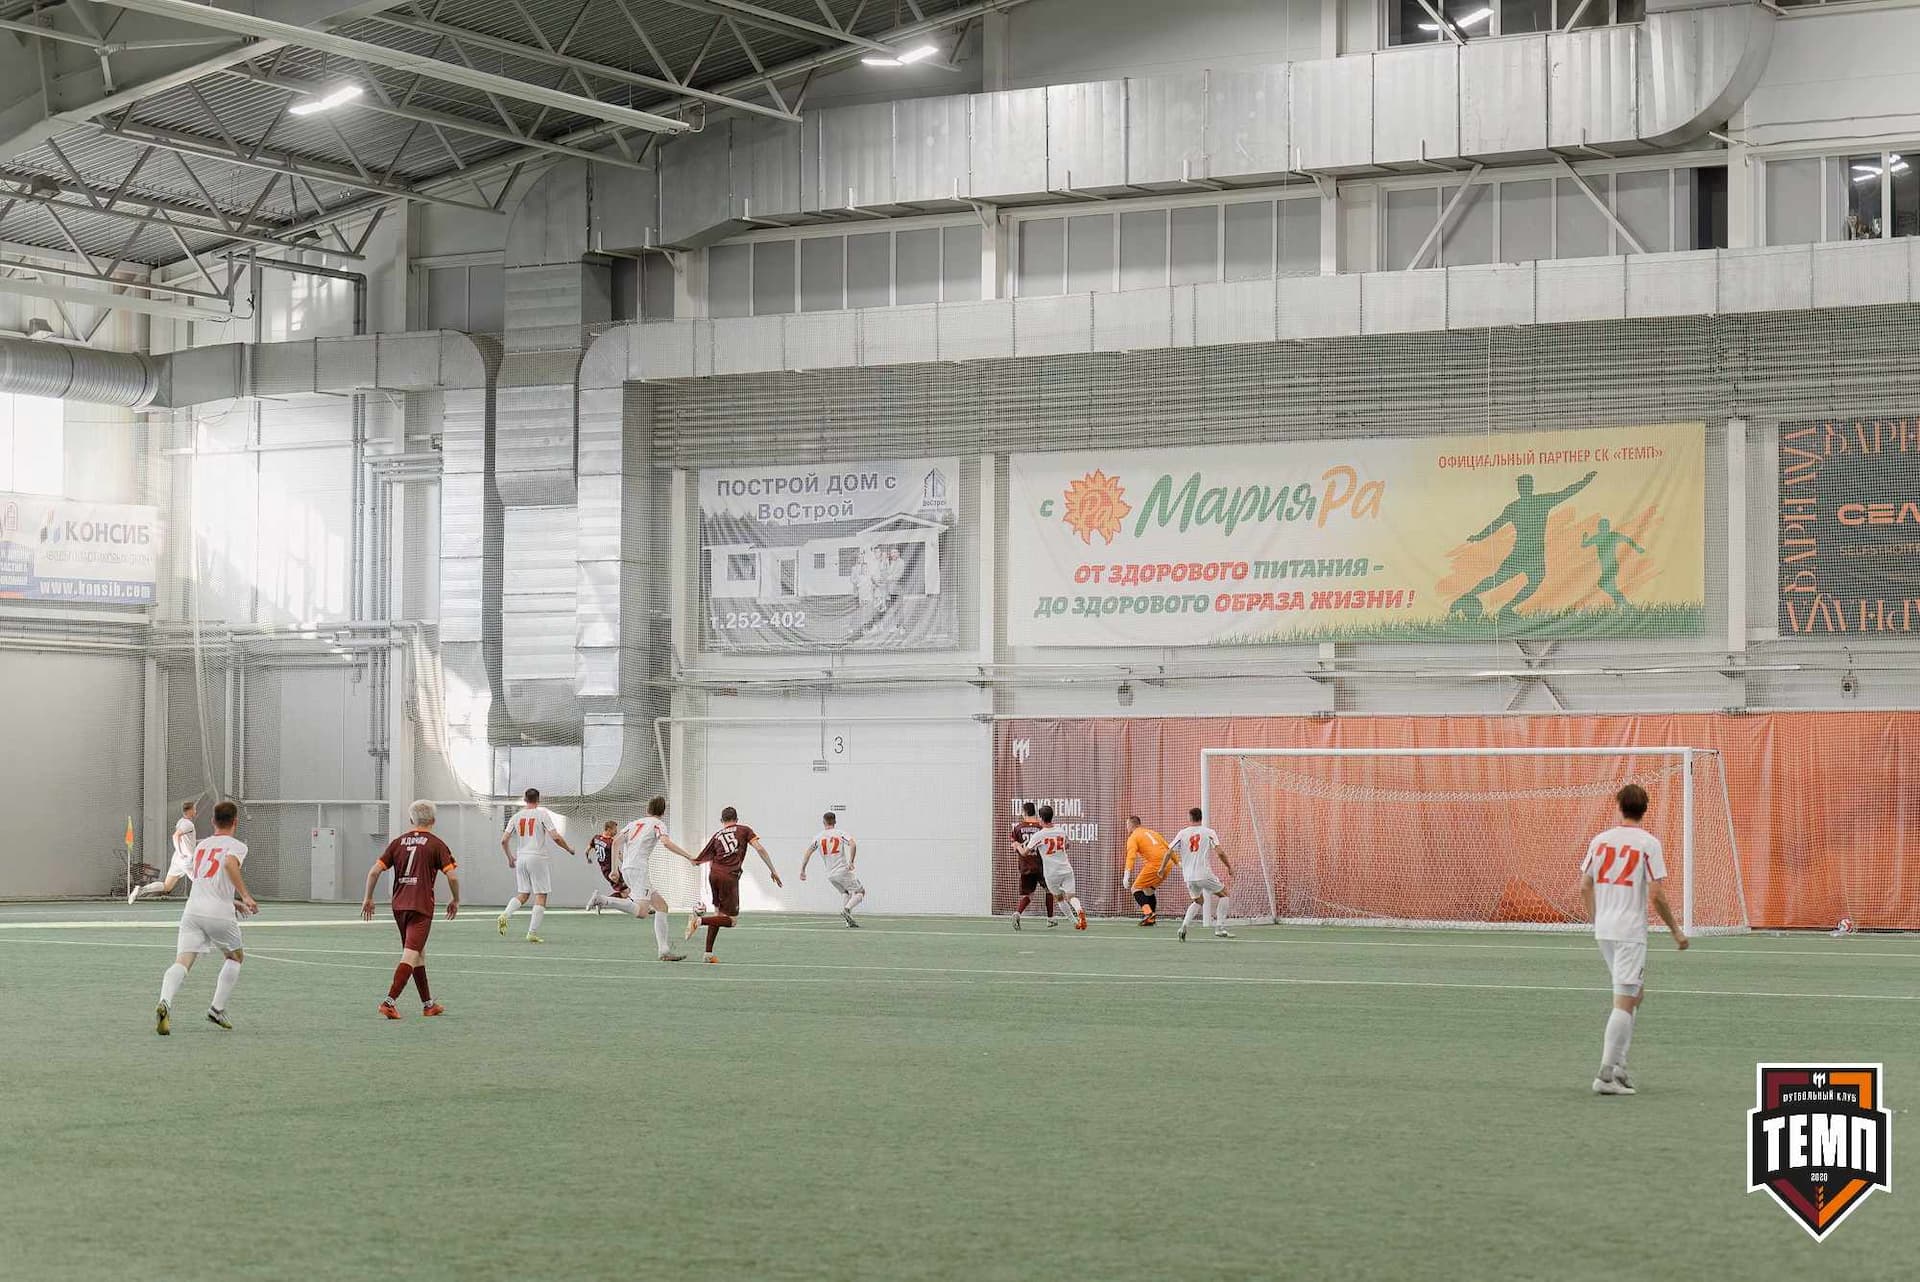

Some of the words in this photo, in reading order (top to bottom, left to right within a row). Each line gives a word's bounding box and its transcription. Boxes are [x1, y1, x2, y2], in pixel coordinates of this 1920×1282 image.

[1438, 450, 1536, 470] ОФИЦИАЛЬНЫЙ
[1539, 450, 1591, 465] ПАРТНЕР
[1595, 449, 1609, 462] СК
[1613, 446, 1663, 460] «ТЕМП»
[717, 473, 818, 497] ПОСТРОЙ
[826, 473, 878, 495] ДОМ
[757, 500, 854, 522] ВоСтрой
[65, 520, 150, 545] КОНСИБ
[1074, 564, 1105, 584] ОТ
[1109, 561, 1249, 586] ЗДОРОВОГО
[1253, 557, 1368, 581] ПИТАНИЯ
[39, 579, 151, 599] www.konsib.com
[1034, 596, 1068, 618] ДО
[1071, 594, 1210, 617] ЗДОРОВОГО
[1215, 591, 1304, 613] ОБРАЗА
[834, 736, 844, 754] 3
[519, 818, 535, 837] 11
[631, 823, 645, 841] 7
[718, 832, 739, 853] 15
[821, 837, 840, 855] 12
[194, 848, 222, 879] 15
[406, 846, 417, 876] 7
[1596, 842, 1640, 887] 22
